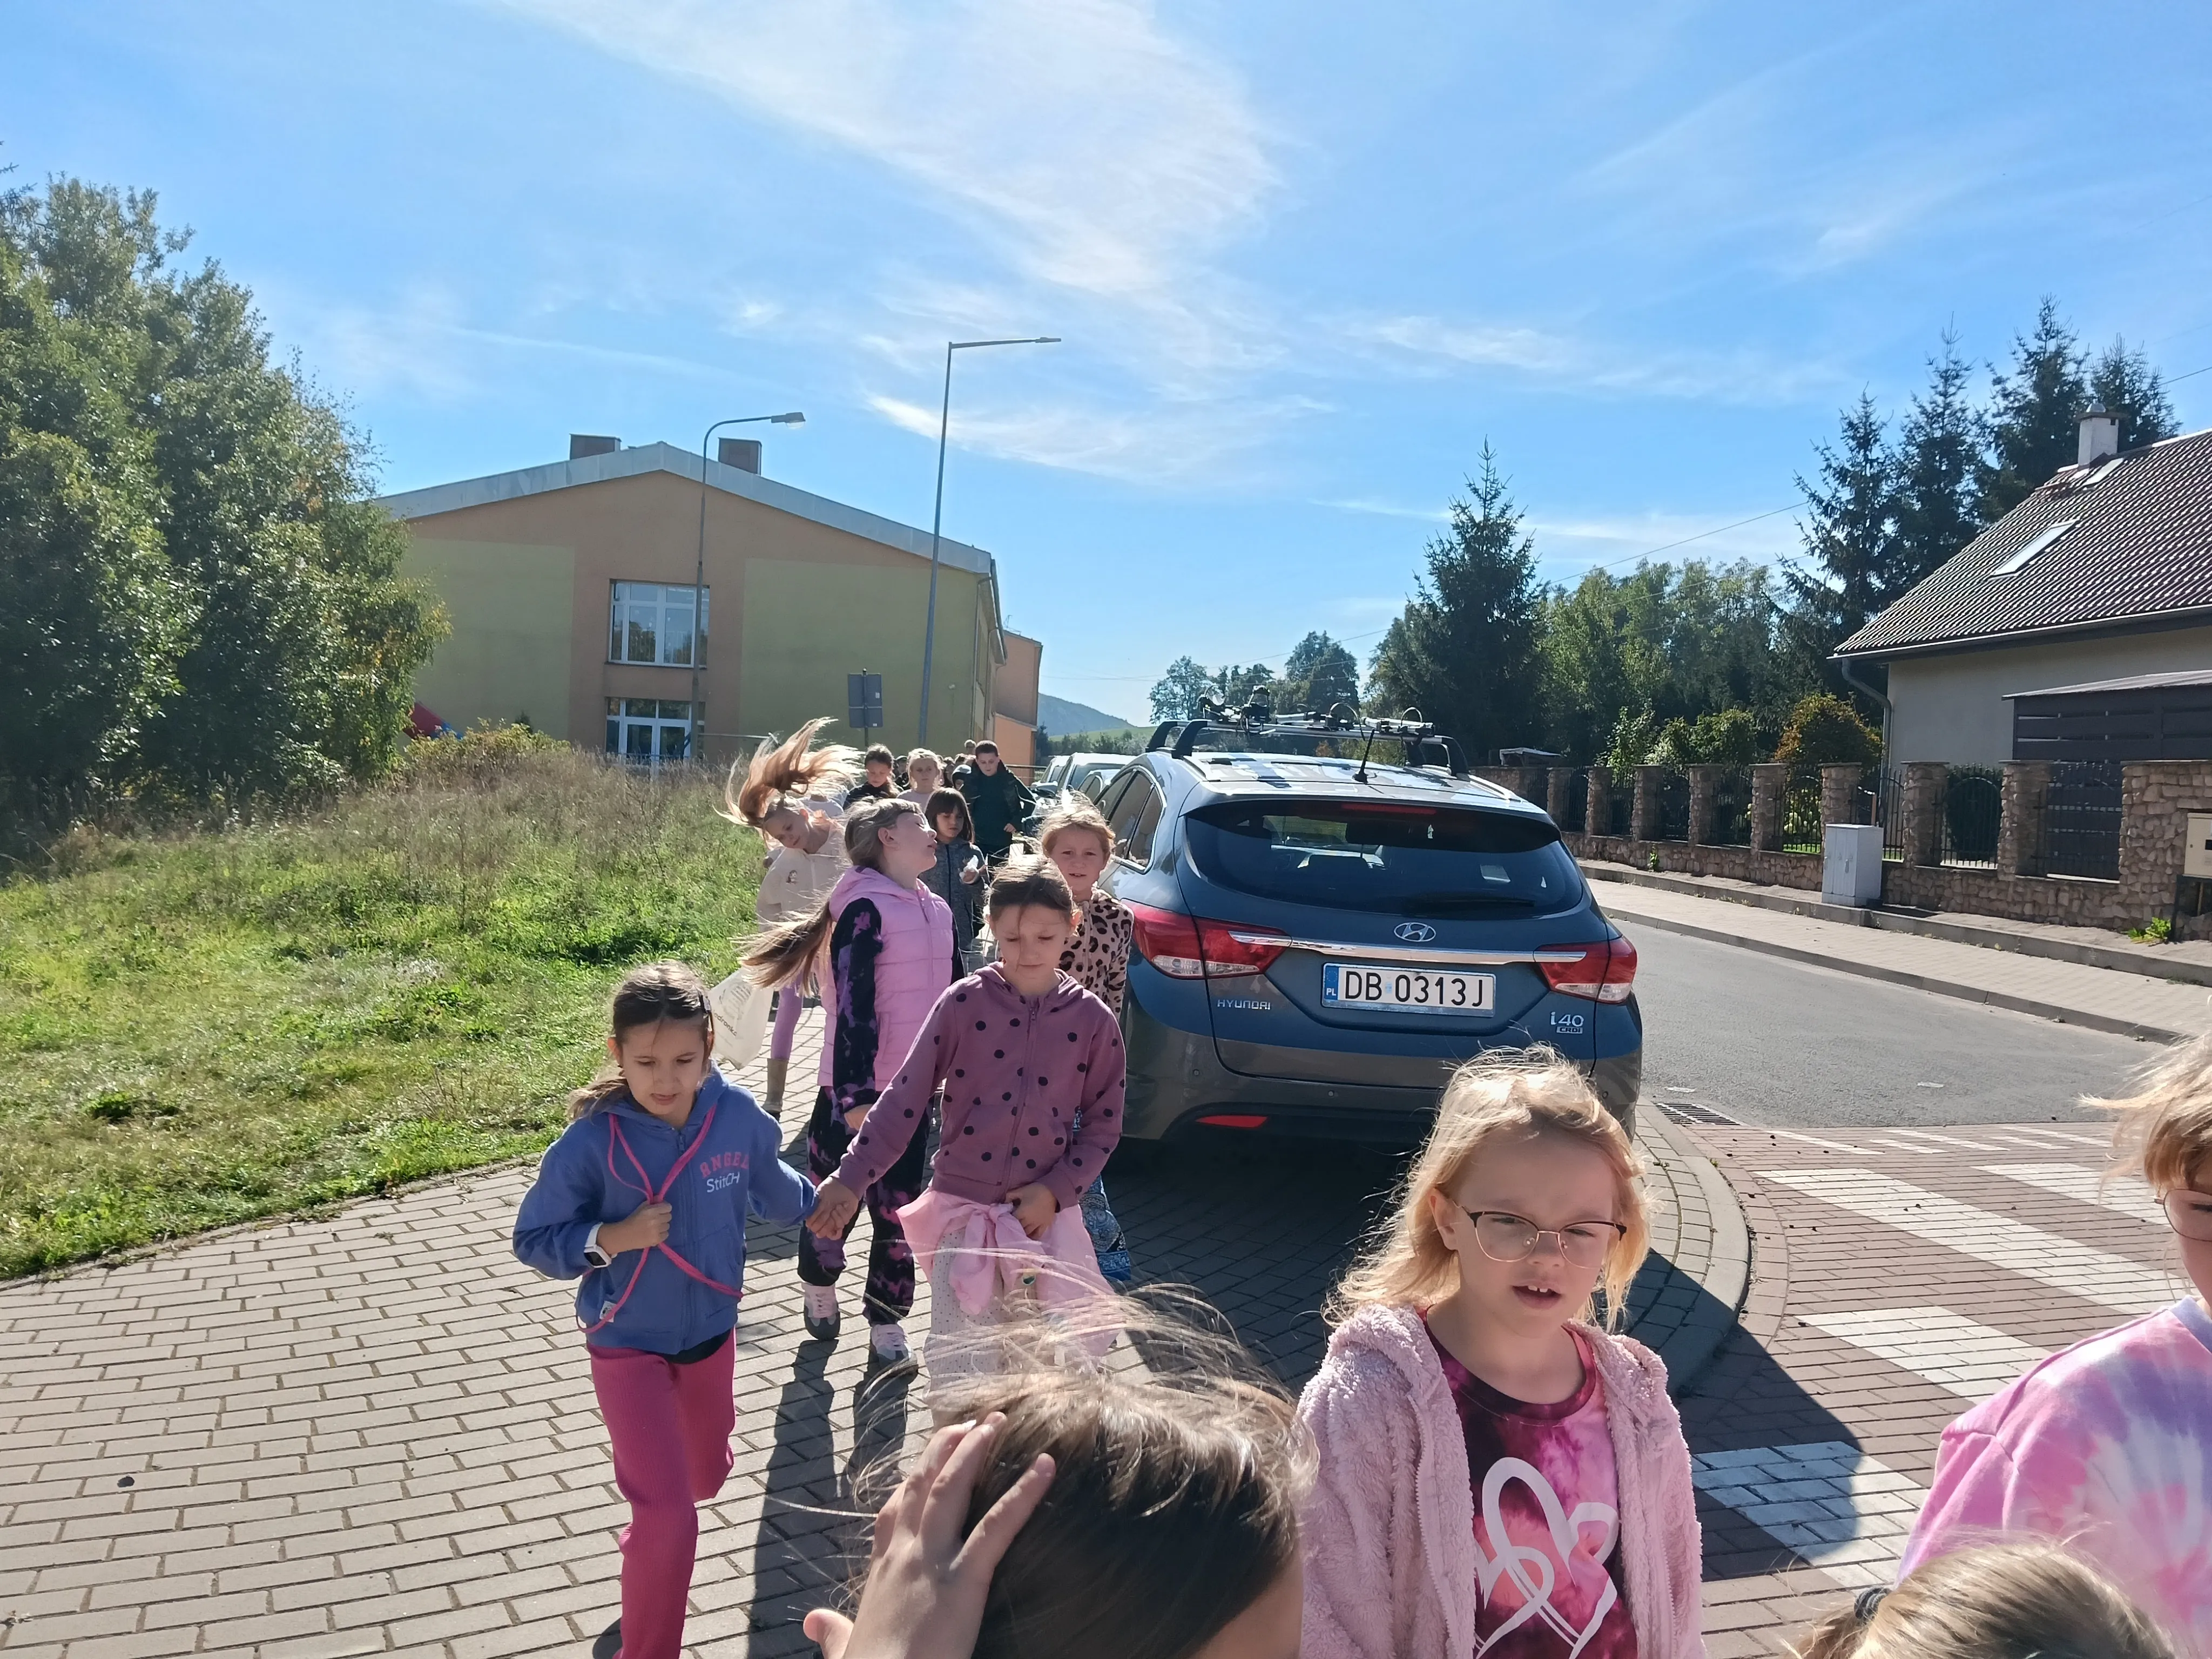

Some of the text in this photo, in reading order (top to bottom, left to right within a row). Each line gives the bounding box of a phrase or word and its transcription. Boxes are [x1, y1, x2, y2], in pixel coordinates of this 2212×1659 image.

[1326, 988, 1337, 996] PL
[1345, 970, 1483, 1007] DB 0313J
[1217, 999, 1271, 1010] HYUNDAI
[1550, 1011, 1584, 1027] i40
